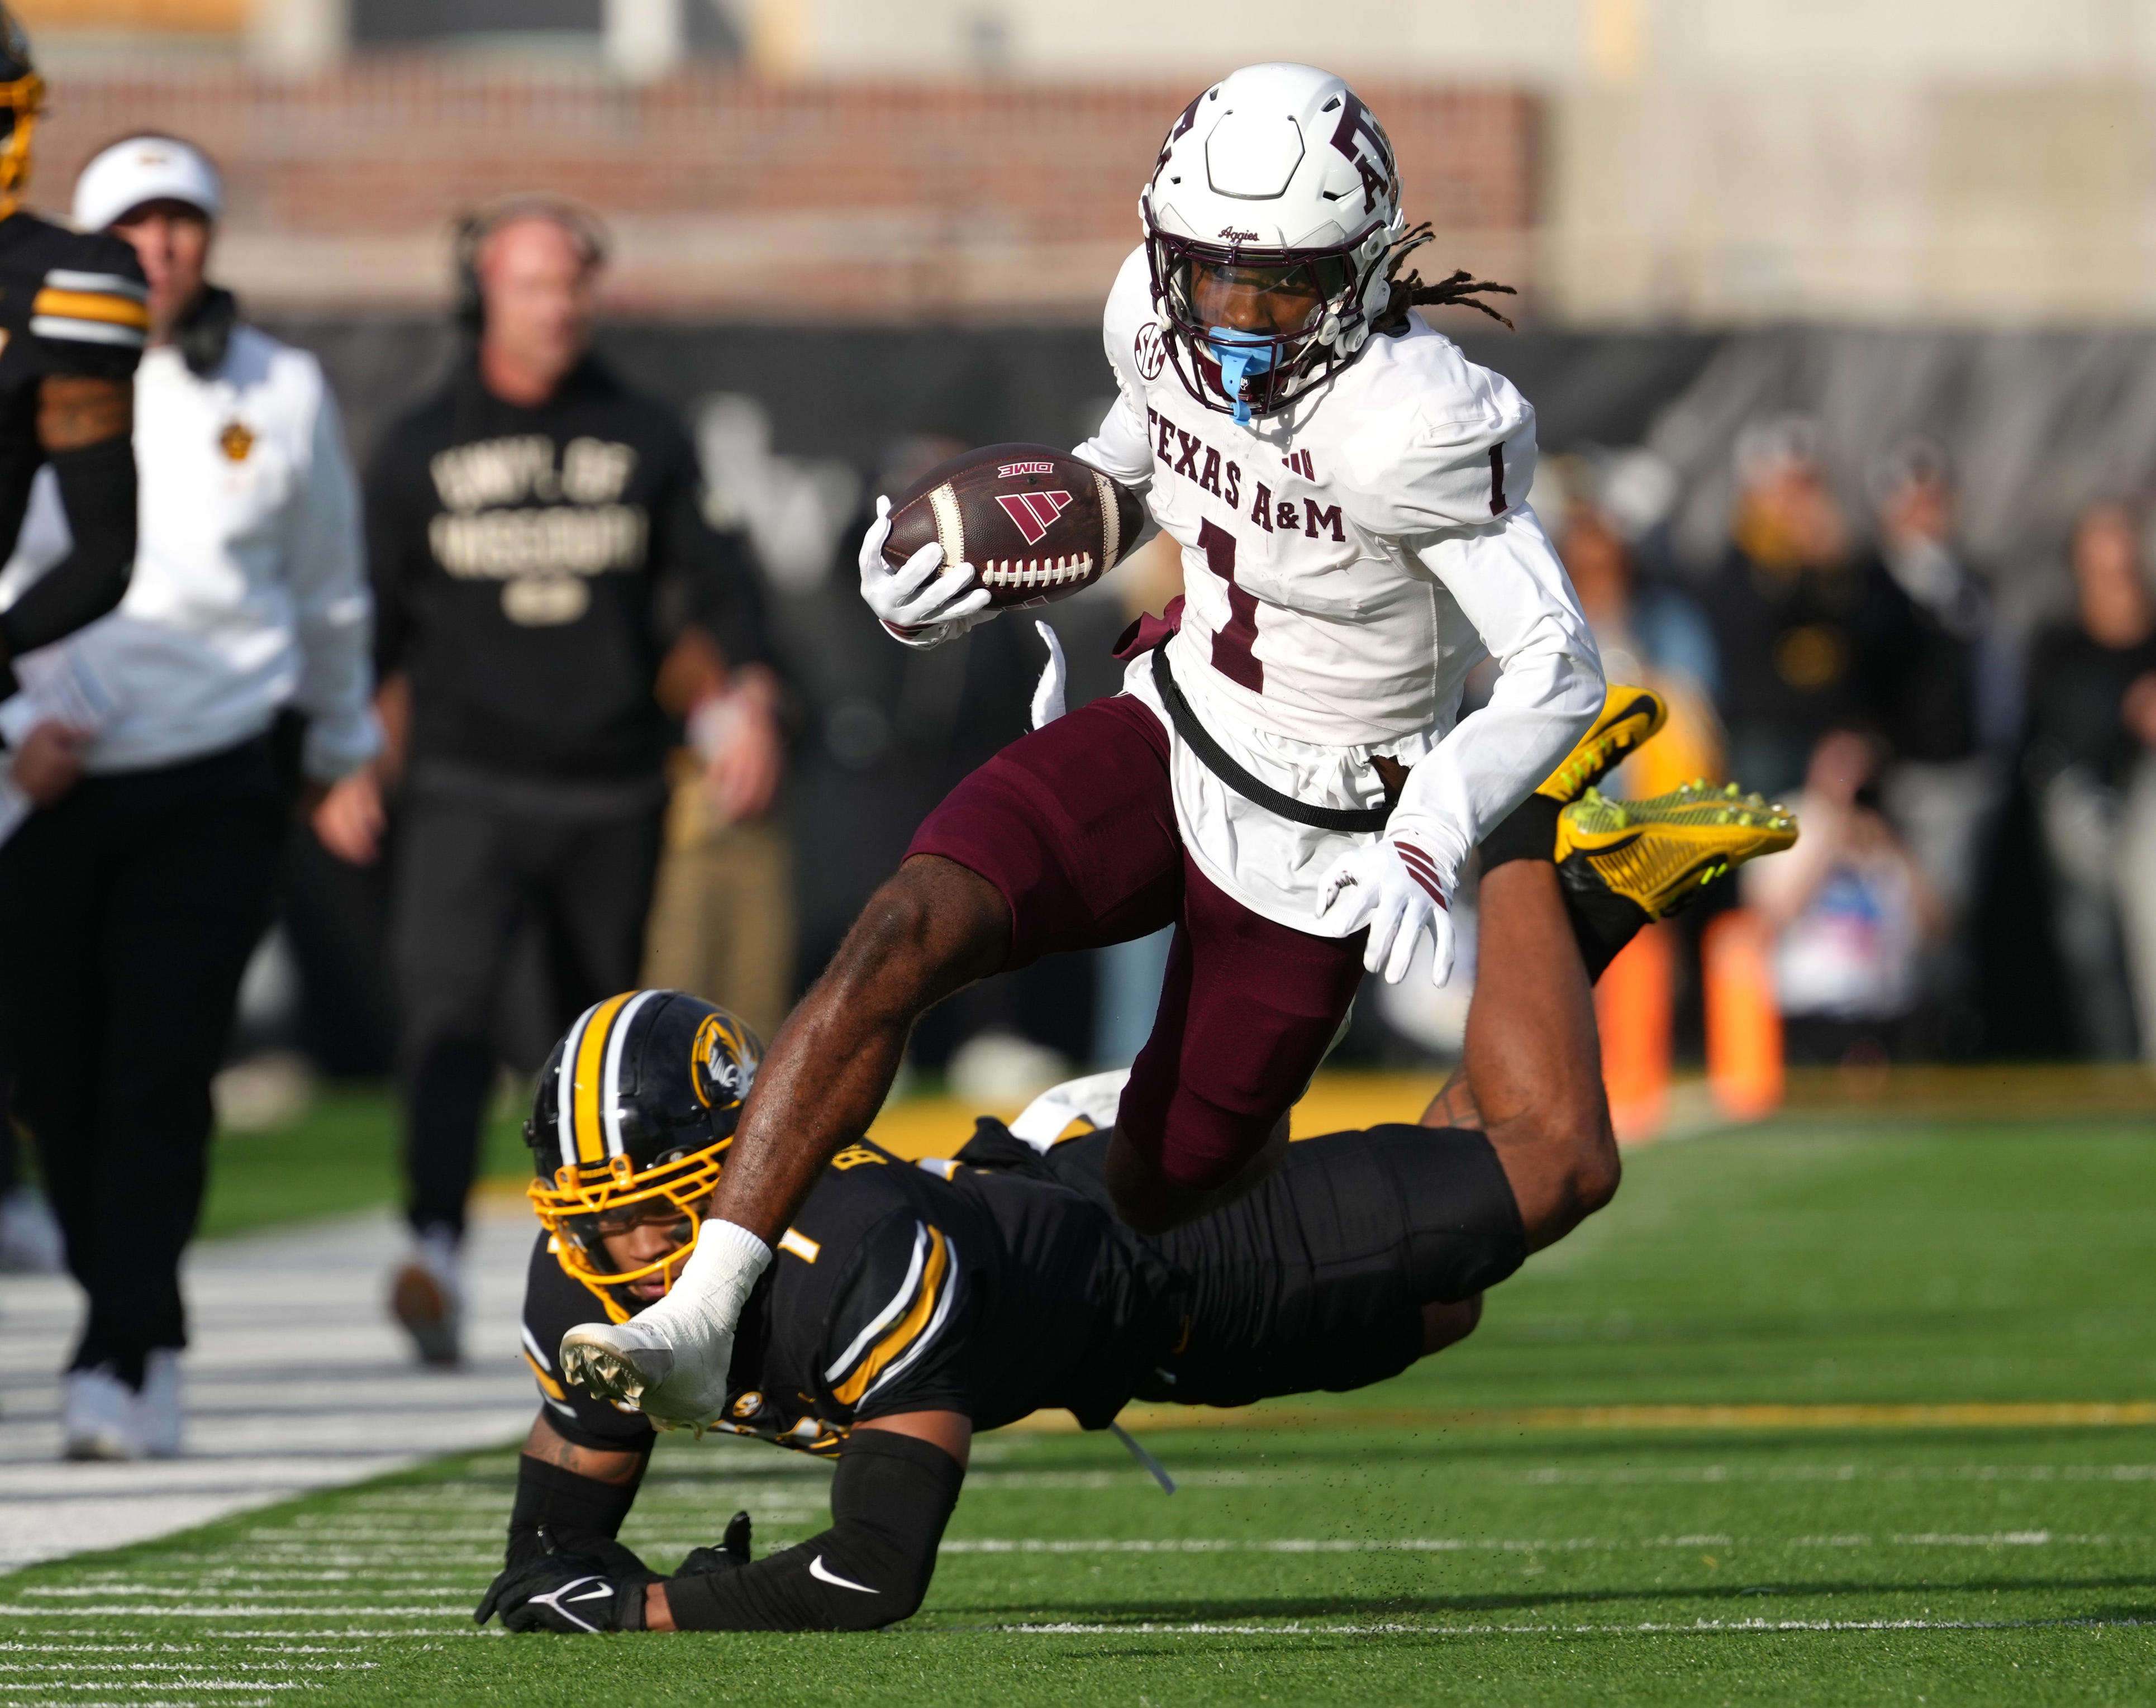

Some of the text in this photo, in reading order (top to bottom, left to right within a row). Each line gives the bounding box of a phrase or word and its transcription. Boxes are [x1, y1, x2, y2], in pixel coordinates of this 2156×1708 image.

[1218, 226, 1260, 244] Aggies
[1135, 325, 1166, 378] SEC
[997, 462, 1054, 478] DIME
[1488, 441, 1508, 516] 1
[1251, 481, 1345, 542] A&M
[1197, 516, 1264, 695] 1
